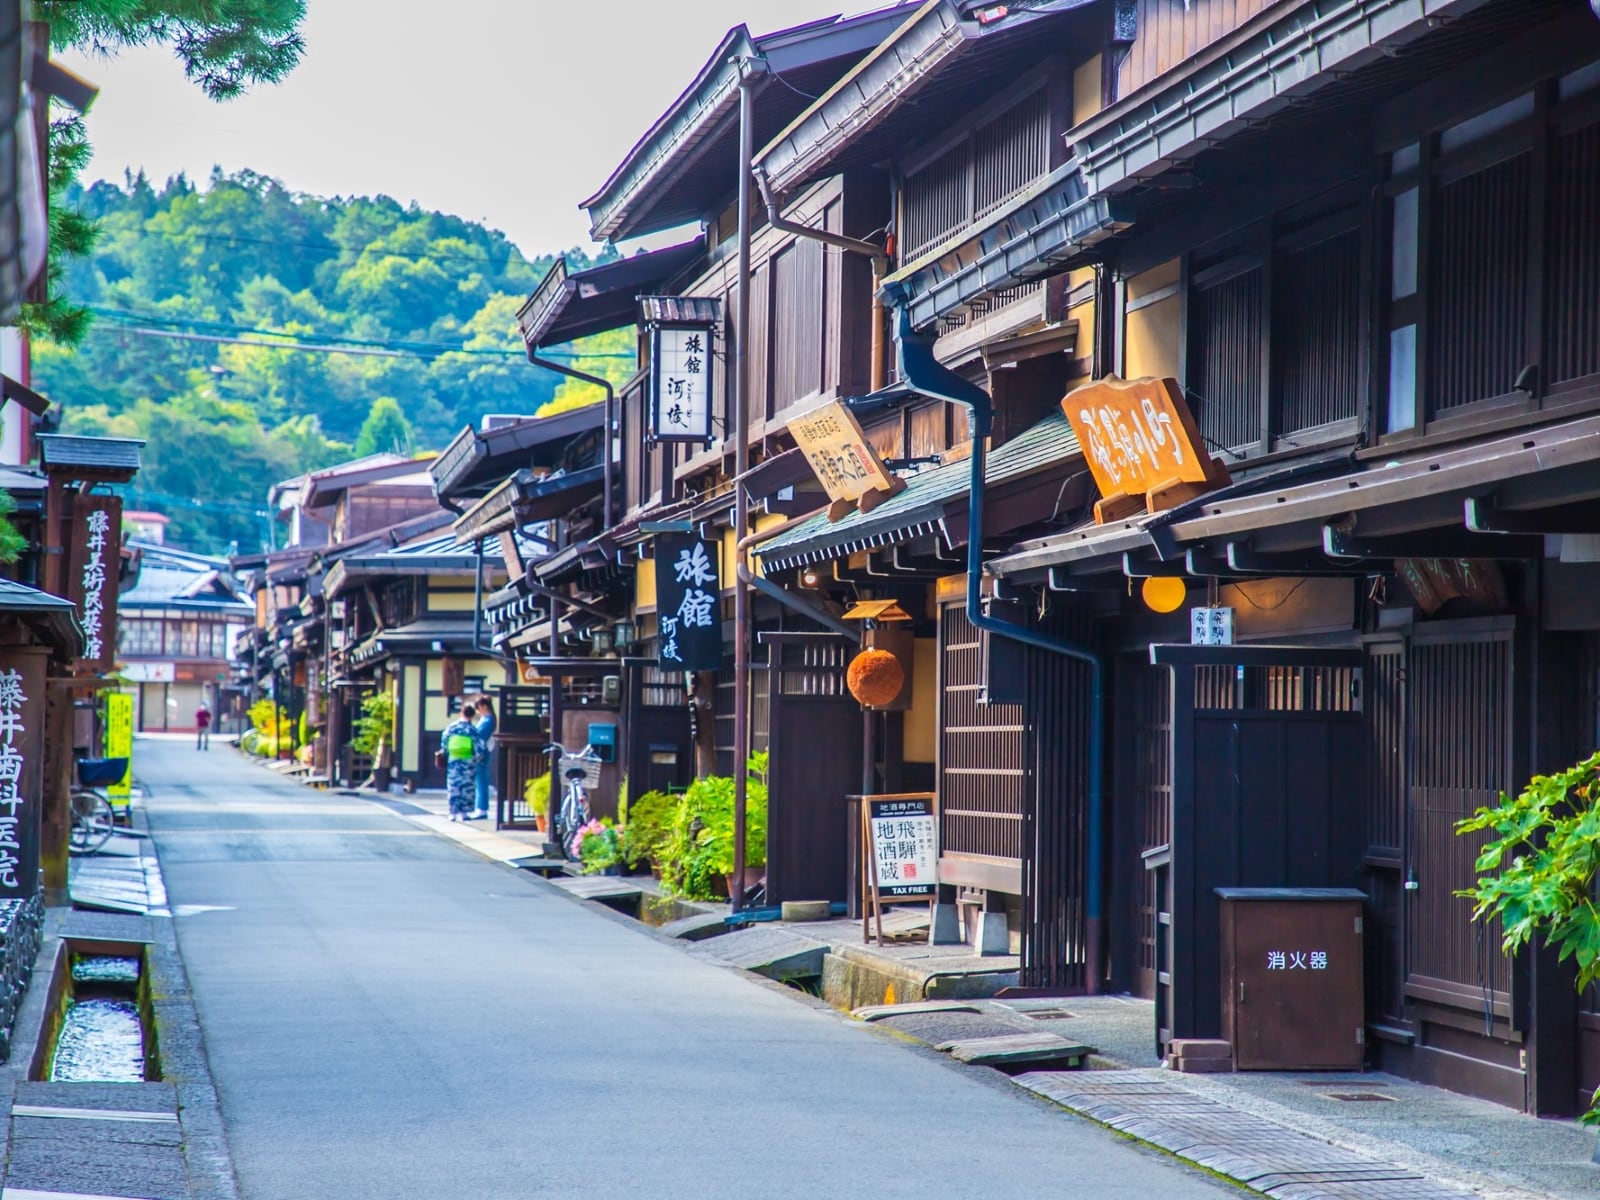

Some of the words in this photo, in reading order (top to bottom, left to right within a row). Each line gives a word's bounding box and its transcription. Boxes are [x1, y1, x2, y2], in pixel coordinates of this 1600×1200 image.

[685, 333, 704, 374] 旅館
[674, 541, 717, 628] 旅館
[877, 821, 899, 880] 地酒蔵
[897, 820, 917, 860] 飛騨
[892, 887, 907, 895] TAX
[908, 886, 928, 894] FREE
[1267, 951, 1328, 970] 消火器
